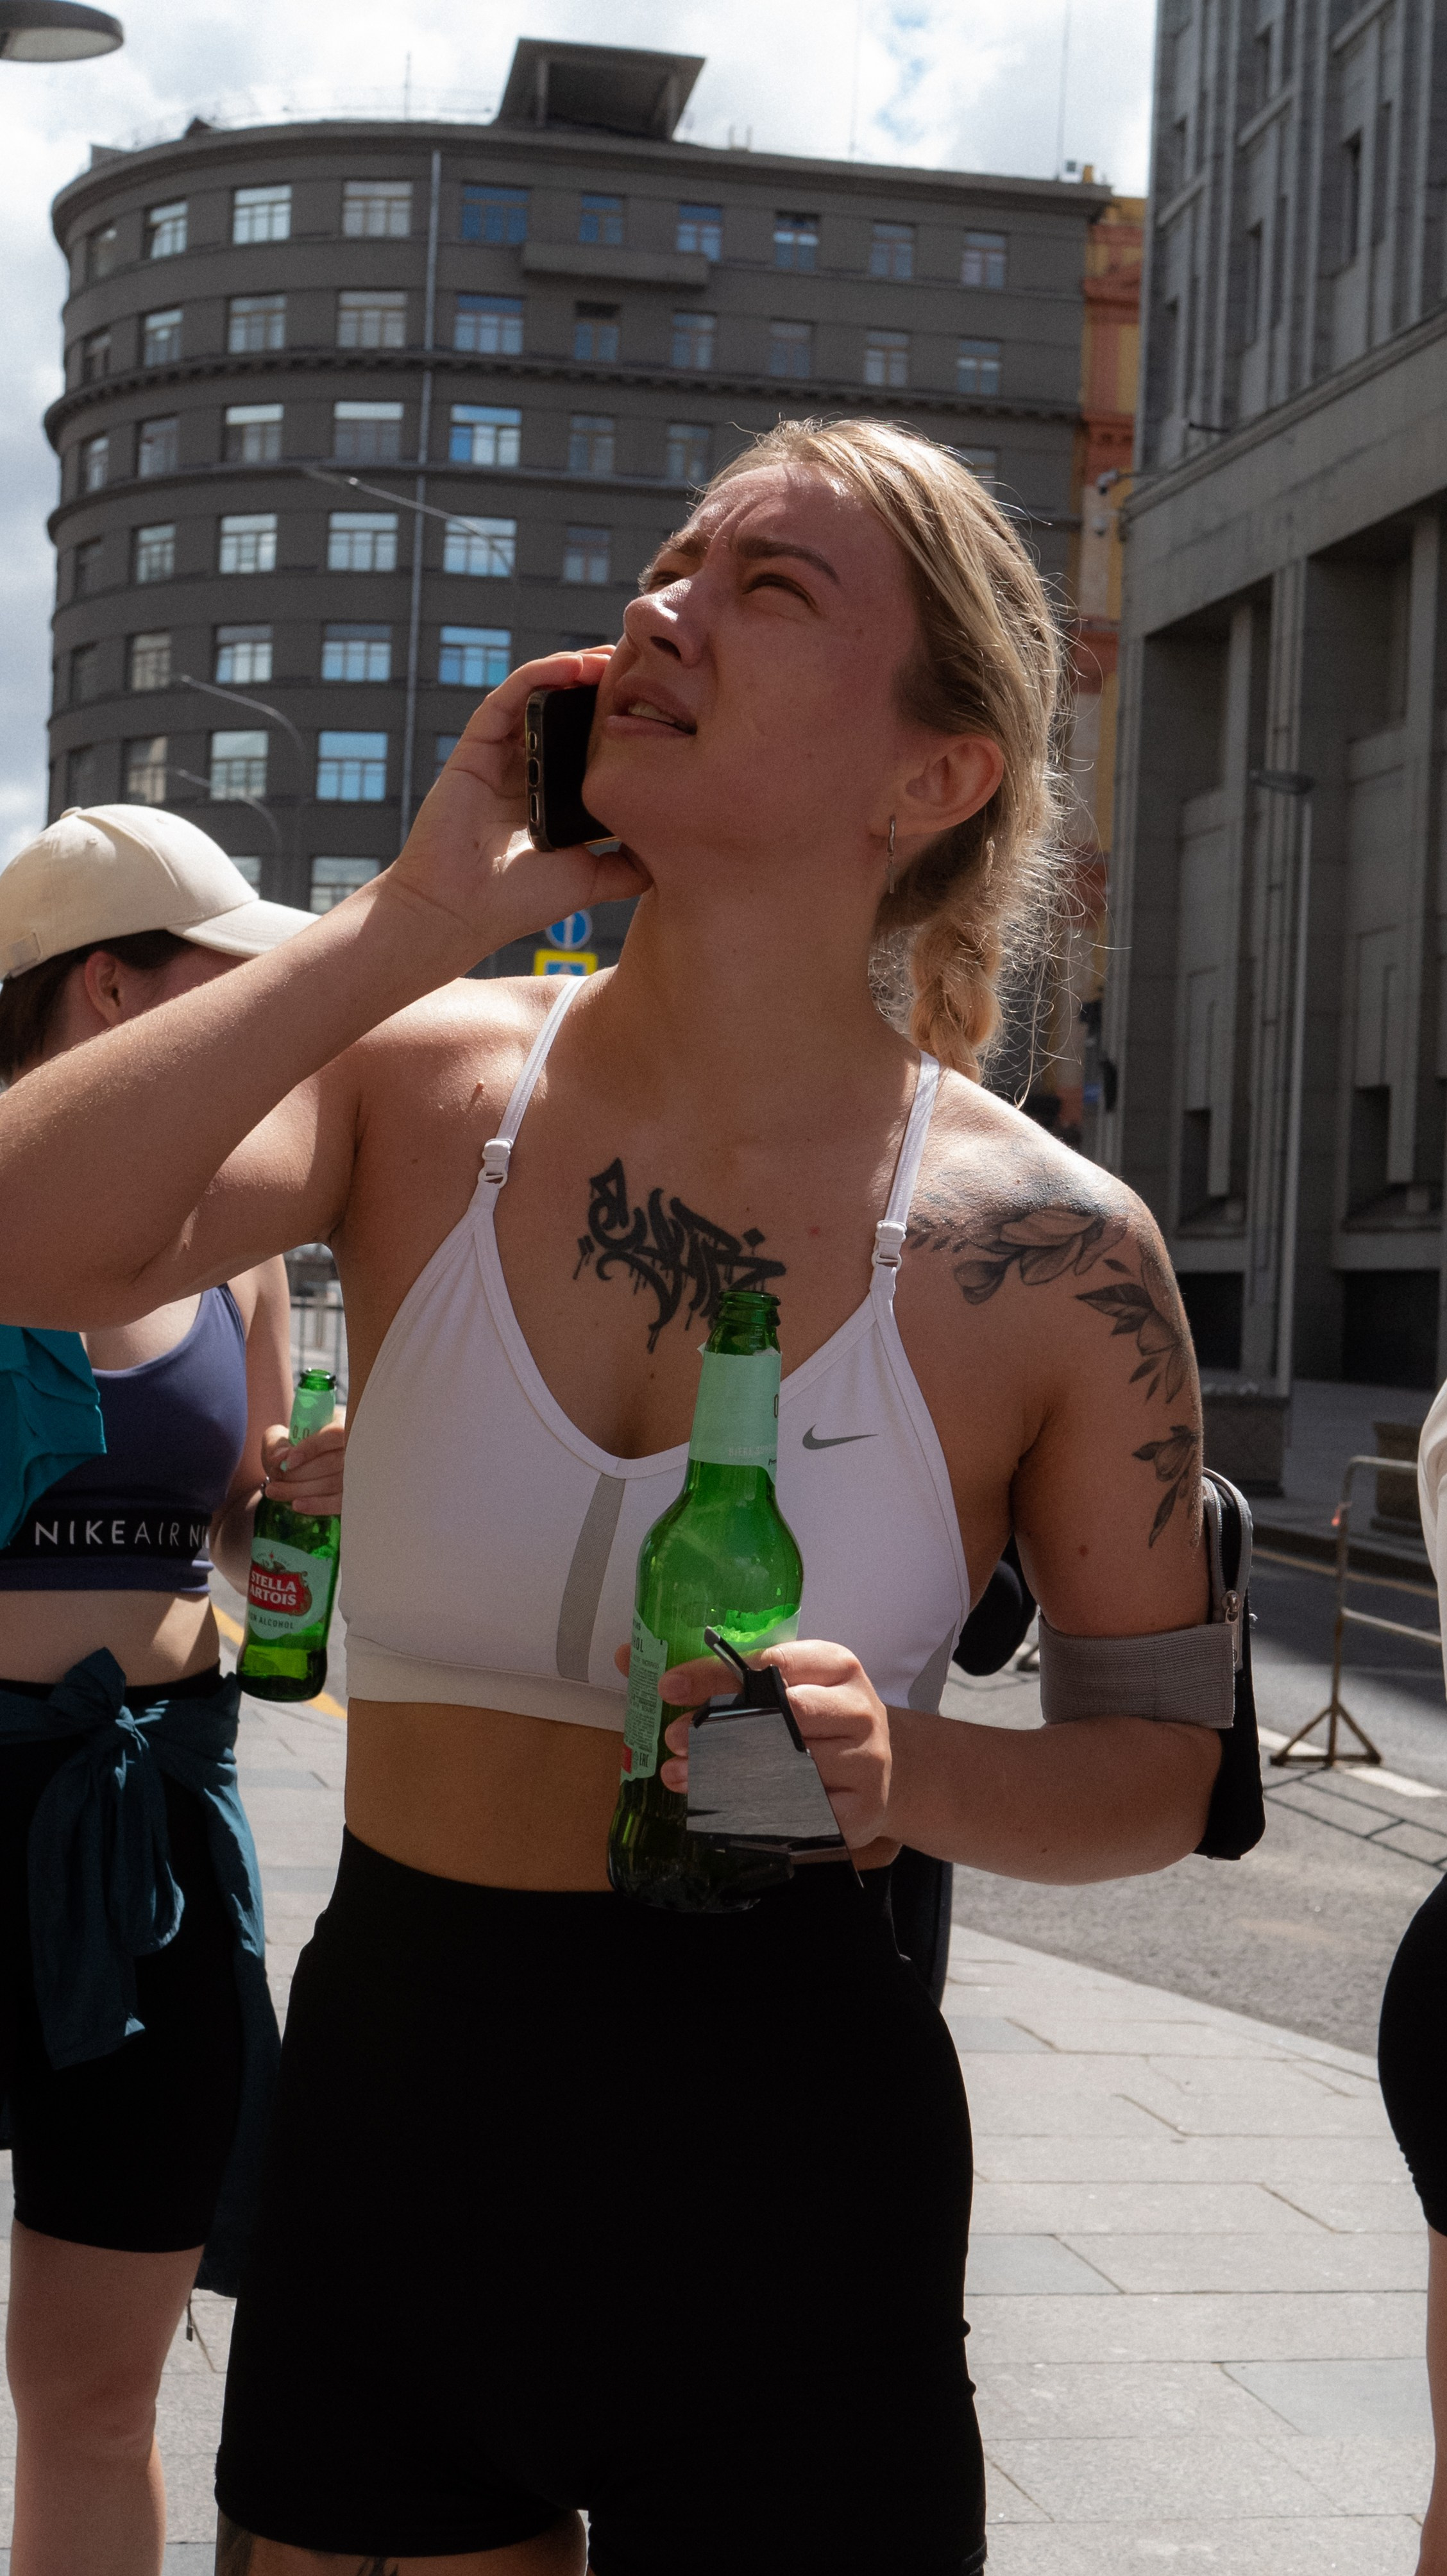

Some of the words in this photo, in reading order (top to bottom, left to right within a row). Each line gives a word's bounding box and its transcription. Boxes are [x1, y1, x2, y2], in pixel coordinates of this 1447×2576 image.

[35, 1520, 126, 1546] NIKE
[134, 1521, 180, 1546] AIR
[251, 1571, 297, 1593] STELLA
[249, 1584, 297, 1606] ARTOIS
[258, 1616, 294, 1629] ALCOHOL
